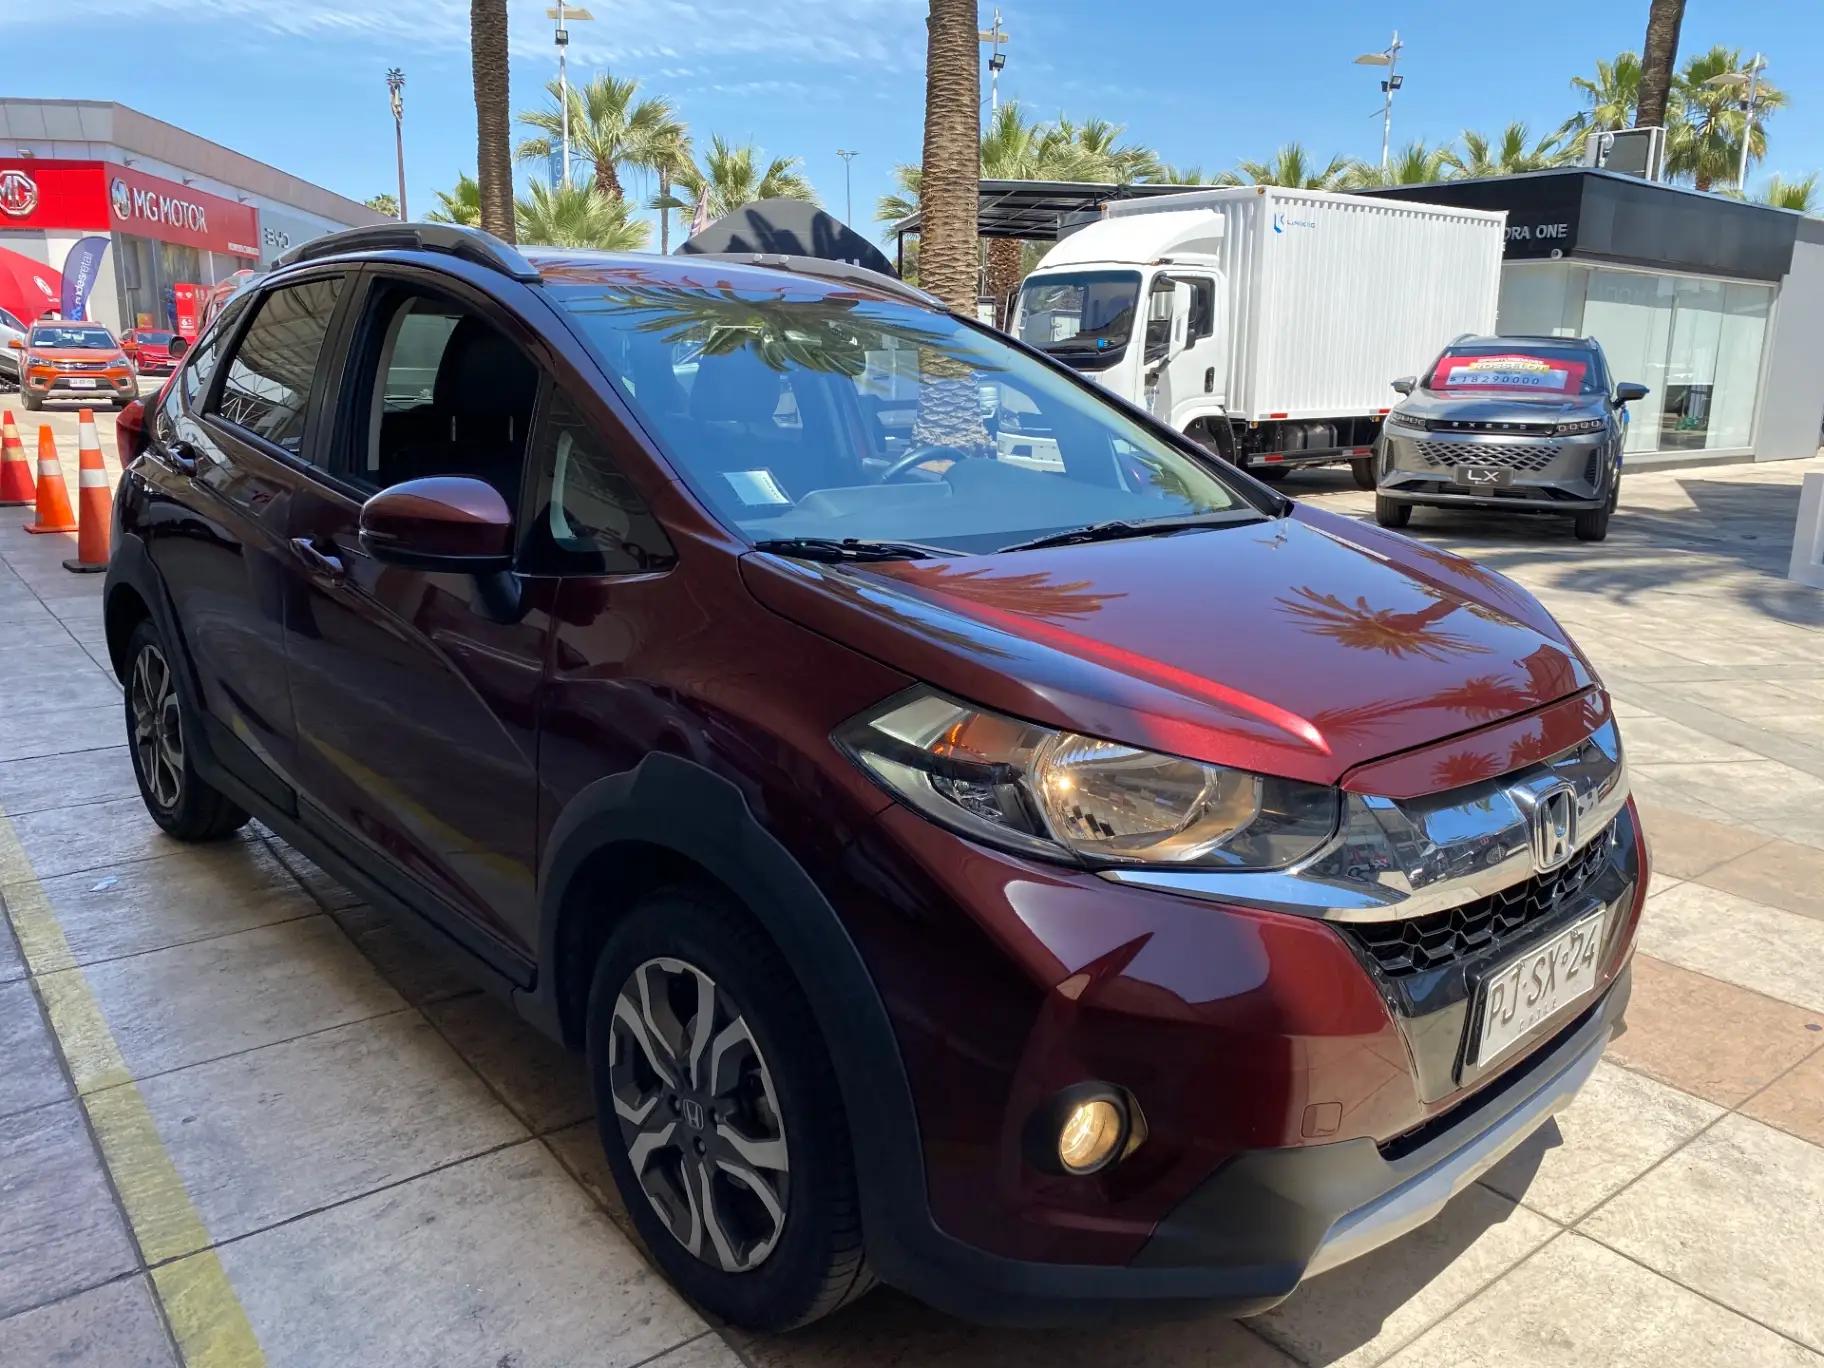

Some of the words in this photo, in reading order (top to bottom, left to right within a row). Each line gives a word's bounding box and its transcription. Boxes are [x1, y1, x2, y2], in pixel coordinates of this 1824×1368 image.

[133, 187, 158, 222] MG
[160, 198, 208, 234] MOTOR
[1536, 223, 1568, 239] ONE
[1467, 469, 1500, 483] LX
